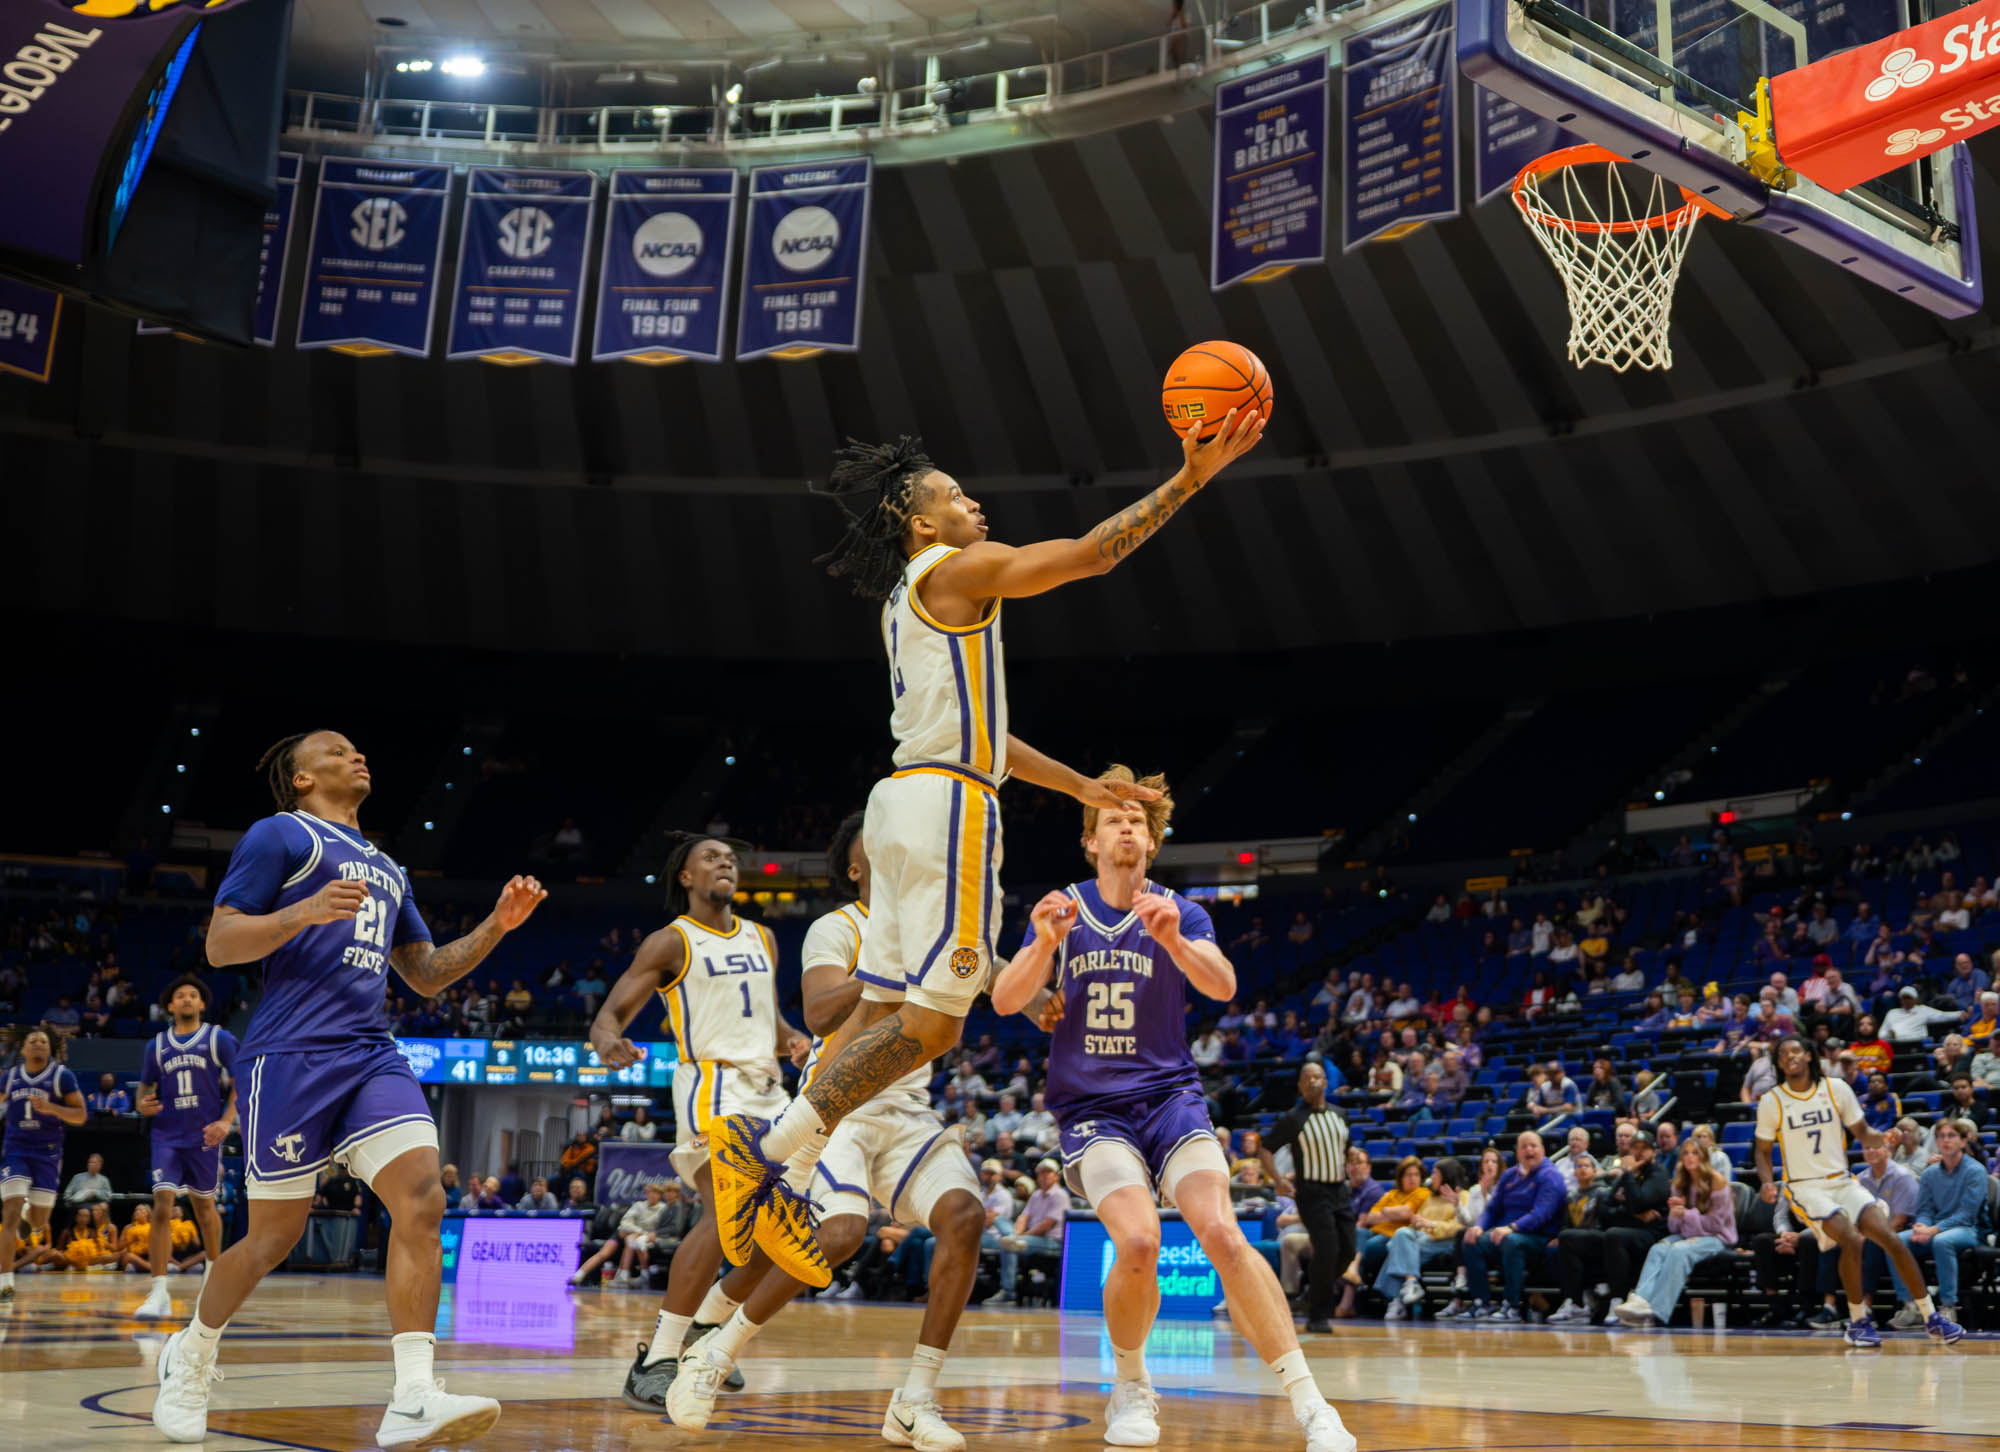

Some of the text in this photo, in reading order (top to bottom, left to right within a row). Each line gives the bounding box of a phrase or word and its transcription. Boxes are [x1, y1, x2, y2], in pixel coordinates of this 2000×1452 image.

[1235, 129, 1309, 169] BREAUX
[351, 197, 408, 250] SEC
[497, 206, 555, 260] SEC
[639, 242, 698, 259] NCAA
[779, 235, 835, 255] NCAA
[622, 298, 700, 312] FINAL FOUR
[763, 290, 838, 310] FINAL FOUR
[631, 315, 687, 336] 1990
[775, 308, 823, 332] 1991
[338, 861, 401, 910] TARLETON
[354, 895, 387, 947] 21
[342, 946, 384, 976] STATE
[704, 953, 768, 977] LSU
[1068, 949, 1153, 979] TARLETON
[739, 979, 753, 1018] 1
[1086, 981, 1135, 1029] 25
[524, 1046, 576, 1066] 10:36
[1084, 1034, 1137, 1055] STATE
[163, 1053, 206, 1075] TARLETON
[451, 1059, 477, 1081] 41
[176, 1069, 193, 1096] 11
[1788, 1108, 1833, 1130] LSU
[1807, 1129, 1822, 1154] 7
[471, 1241, 511, 1261] GEAUX
